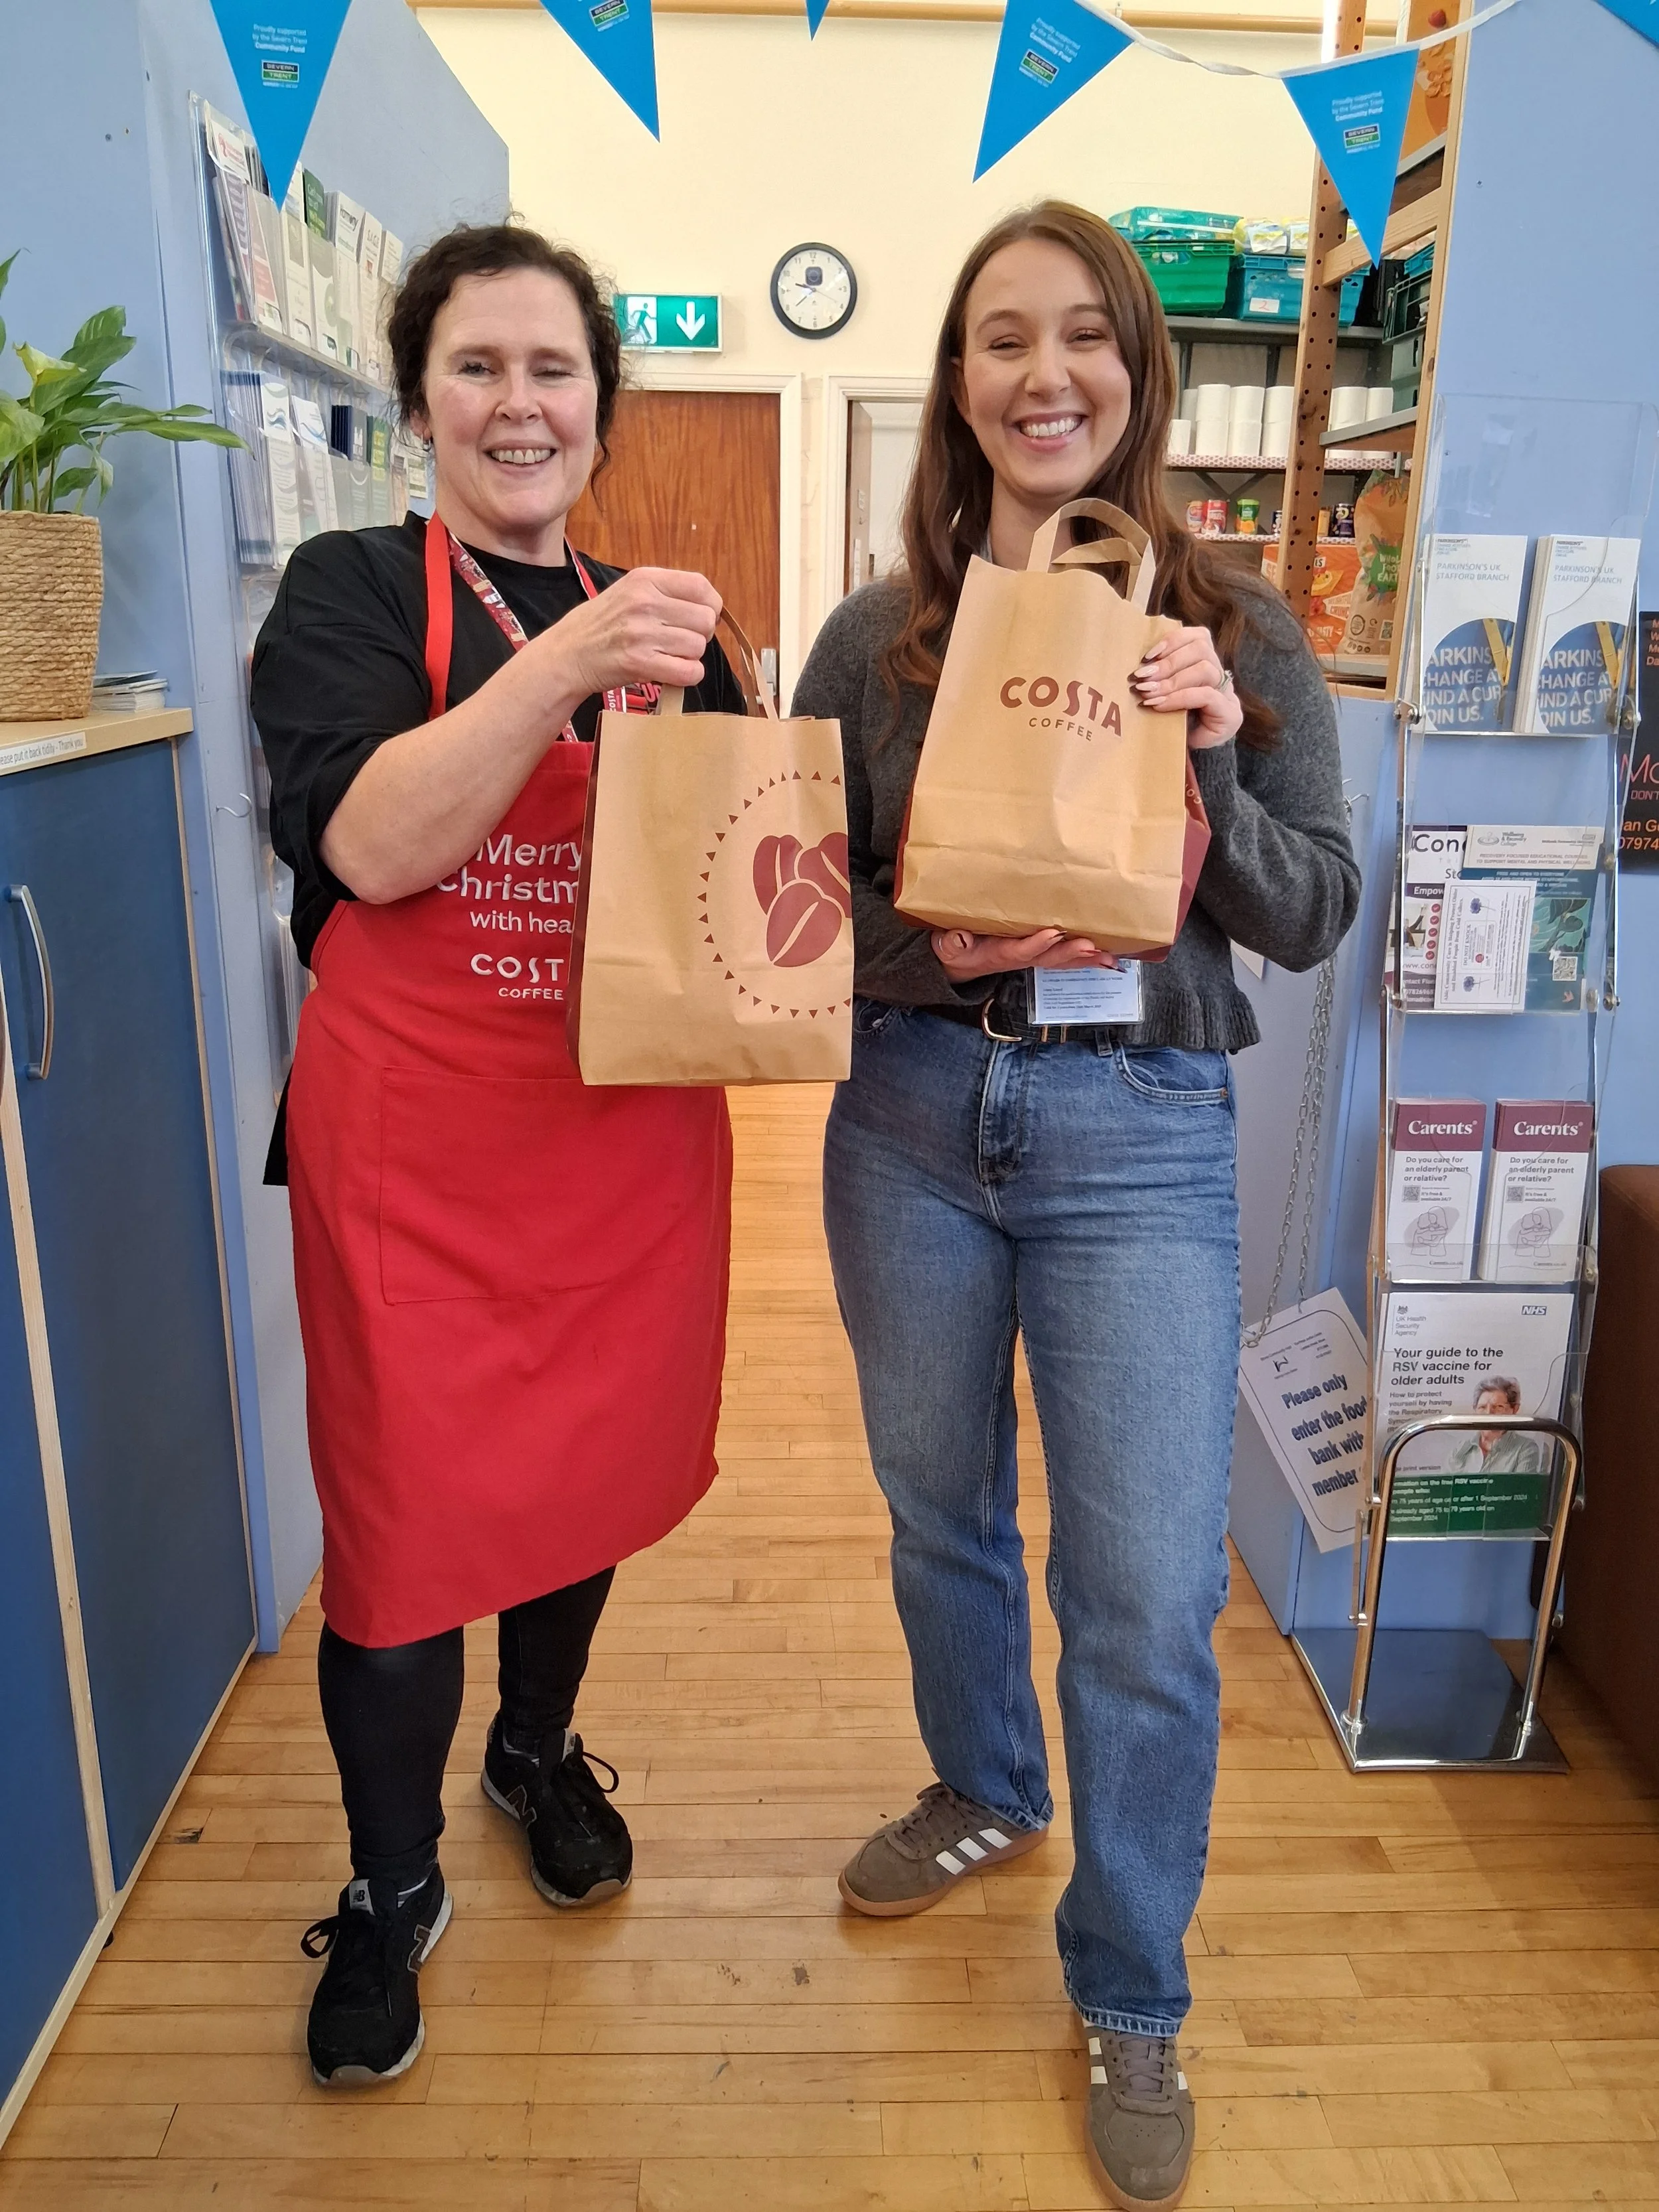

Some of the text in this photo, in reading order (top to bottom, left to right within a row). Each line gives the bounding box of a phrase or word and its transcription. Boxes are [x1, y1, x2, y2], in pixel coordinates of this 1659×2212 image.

[1258, 301, 1269, 310] 2
[1457, 689, 1469, 703] A
[1570, 691, 1581, 707] A
[1001, 676, 1121, 737] COSTA
[1459, 705, 1484, 723] US.
[1570, 708, 1595, 725] US.
[1029, 717, 1092, 741] COFFEE
[14, 751, 23, 764] put
[29, 744, 42, 759] back
[58, 738, 73, 750] Thank
[74, 739, 83, 749] you
[476, 834, 581, 871] Merry
[470, 911, 572, 934] with hea
[470, 954, 564, 983] COST
[498, 988, 563, 1000] COFFEE
[1408, 1120, 1473, 1135] Carents
[1514, 1122, 1578, 1136] Carents
[1522, 1306, 1546, 1315] NHS
[1394, 1347, 1503, 1359] Your guide to the
[1393, 1361, 1492, 1372] RSV vaccine for
[1391, 1374, 1465, 1386] older adults
[1281, 1374, 1348, 1409] Please only
[1291, 1419, 1323, 1441] enter
[1321, 1410, 1344, 1430] the
[1308, 1440, 1342, 1465] bank
[1311, 1469, 1359, 1497] member
